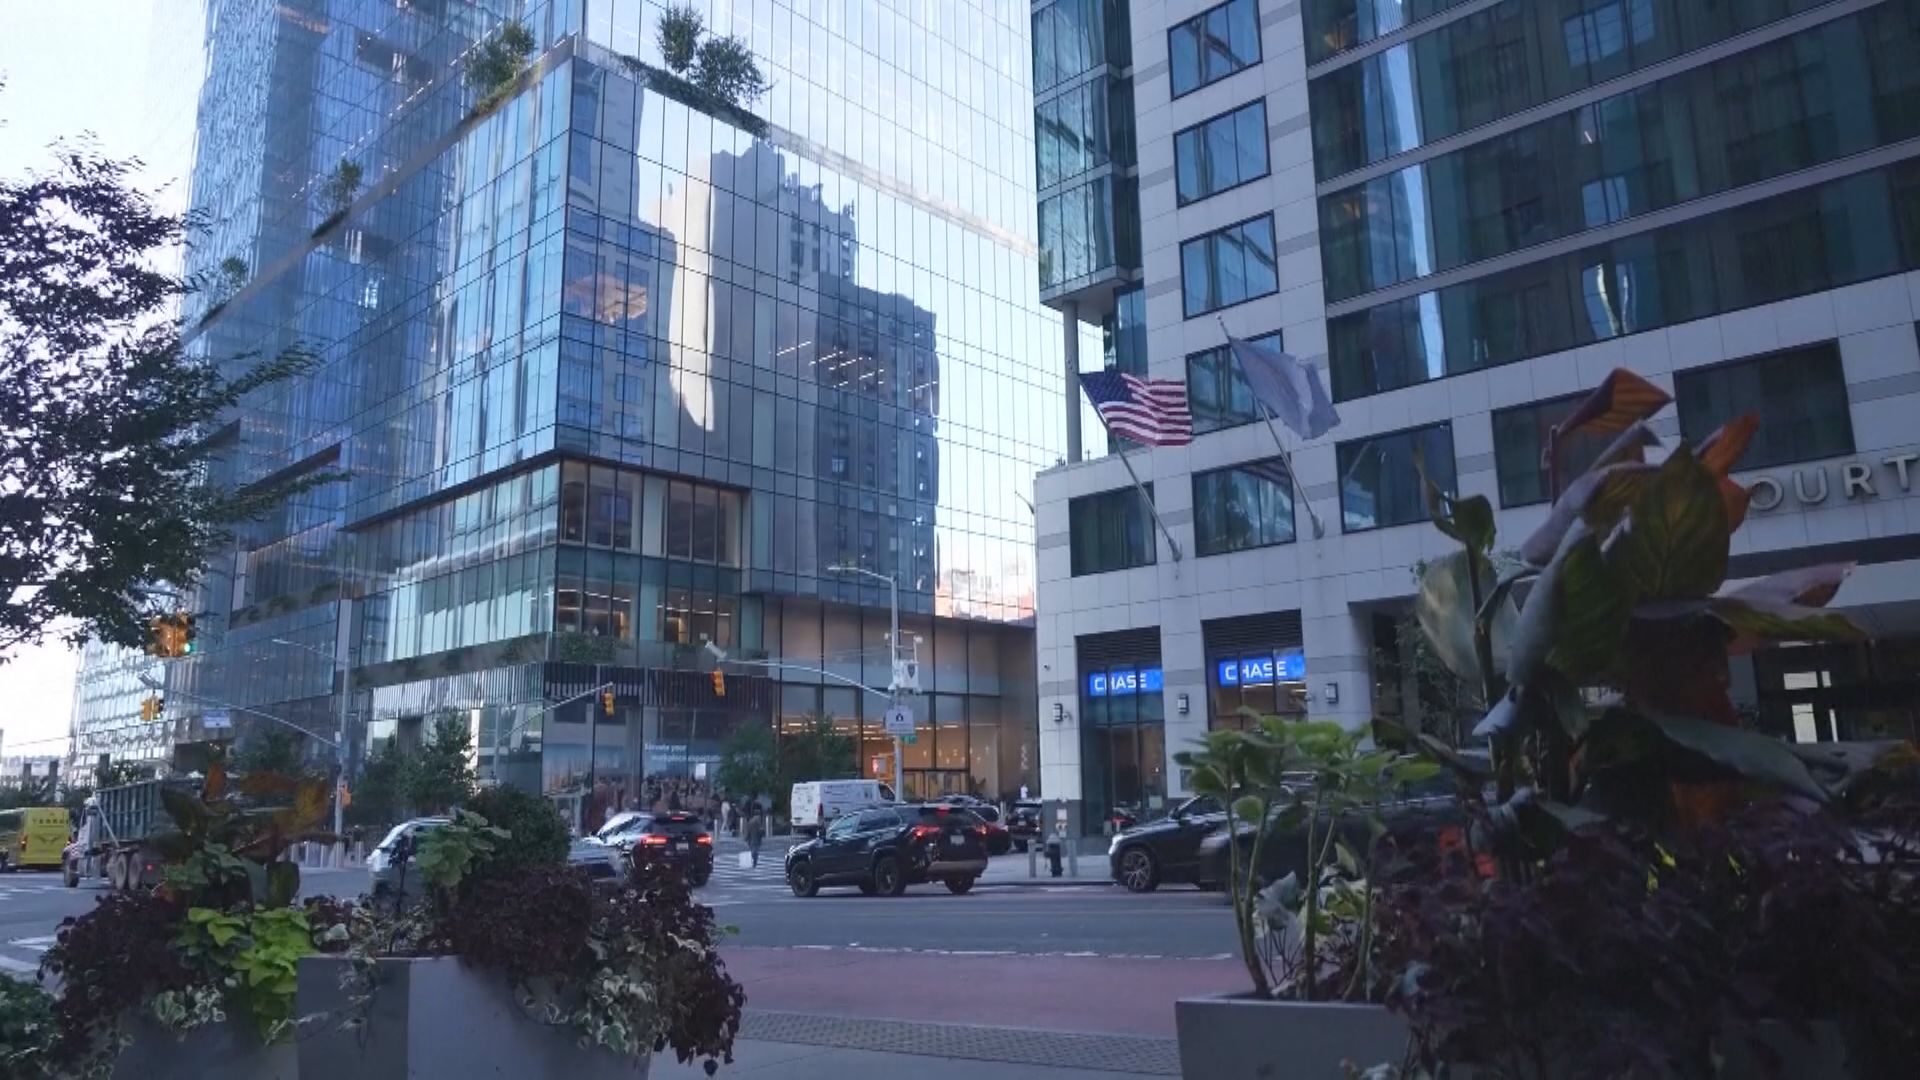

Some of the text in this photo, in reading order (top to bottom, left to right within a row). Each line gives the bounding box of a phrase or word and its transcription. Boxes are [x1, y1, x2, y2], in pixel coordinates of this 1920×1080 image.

[1749, 453, 1919, 511] OURT
[1225, 661, 1287, 681] CHASE
[1094, 672, 1147, 691] CHASE
[671, 744, 687, 753] your
